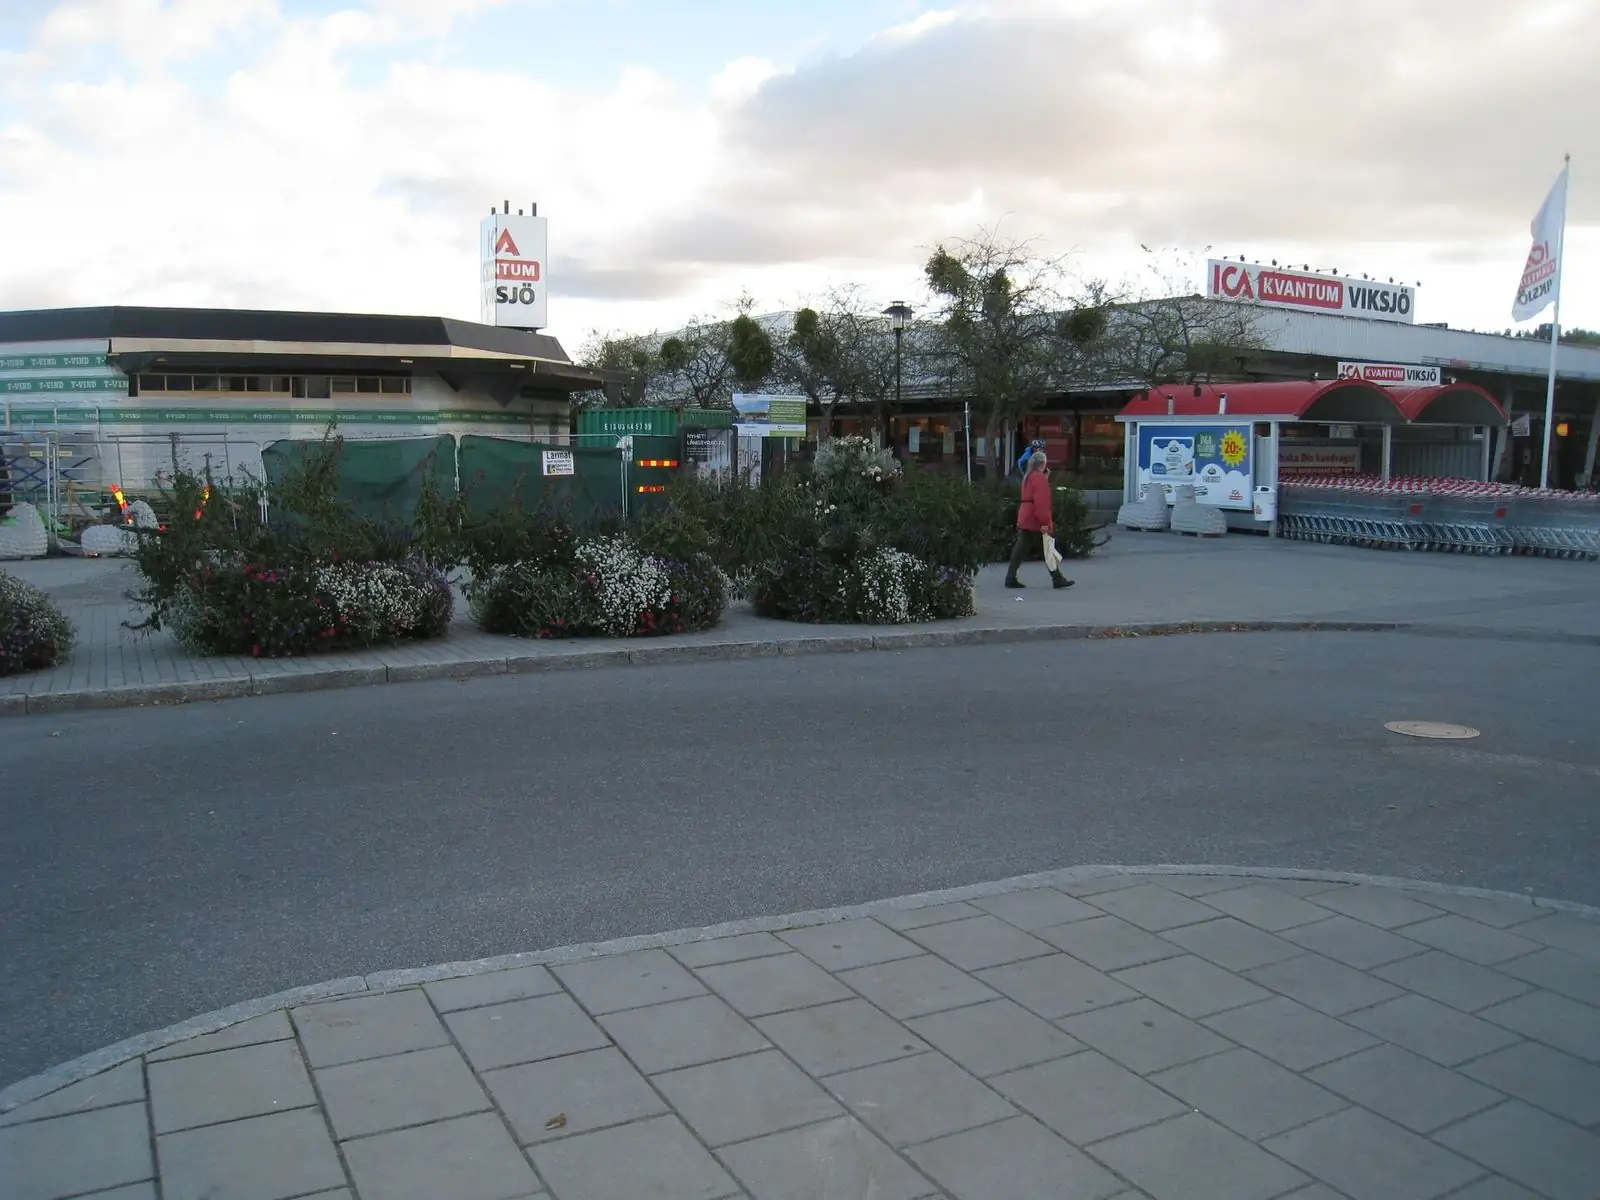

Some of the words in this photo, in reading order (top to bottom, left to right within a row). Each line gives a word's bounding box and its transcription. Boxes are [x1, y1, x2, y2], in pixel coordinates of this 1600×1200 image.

[1214, 264, 1254, 299] ICA
[1263, 277, 1339, 302] KVANTUM
[1348, 286, 1410, 314] VIKSJÖ
[63, 357, 89, 365] T-VIND
[1365, 367, 1404, 378] KVANTUM
[1407, 368, 1437, 382] VIKSJÖ
[39, 381, 64, 389] T-VIND
[71, 380, 97, 389] T-VIND
[103, 380, 129, 388] T-VIN
